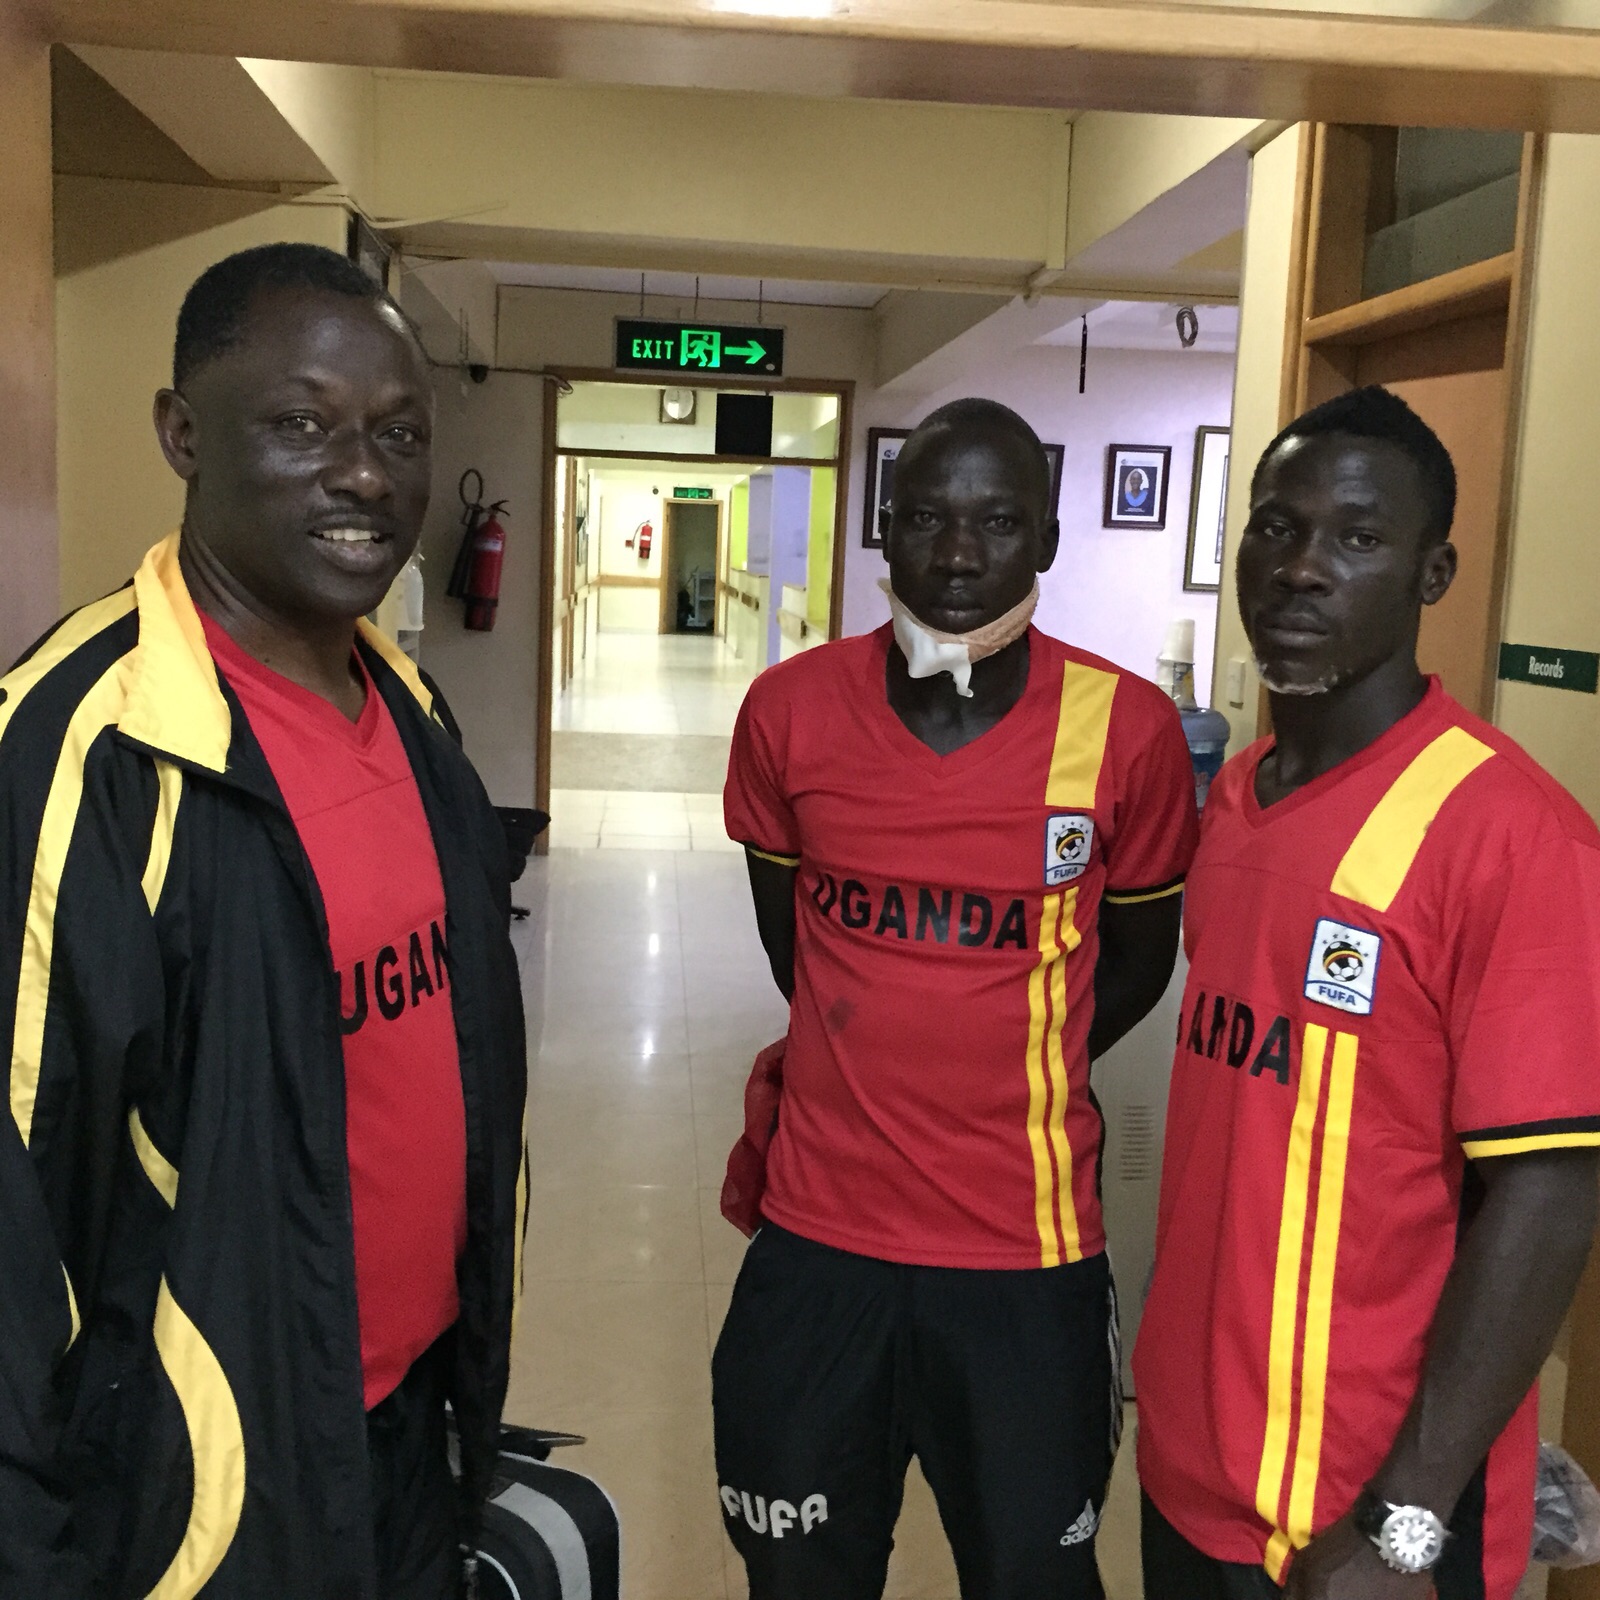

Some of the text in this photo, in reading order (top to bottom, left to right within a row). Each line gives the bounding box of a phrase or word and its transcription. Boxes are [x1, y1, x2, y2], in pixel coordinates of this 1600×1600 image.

[632, 339, 674, 360] EXIT
[1528, 655, 1564, 679] Records
[1053, 866, 1078, 879] FUFA
[812, 872, 1028, 950] UGANDA
[335, 920, 450, 1036] UGAN
[1318, 985, 1356, 1006] FUFA
[1177, 991, 1291, 1085] ANDA
[720, 1485, 828, 1539] FUFA
